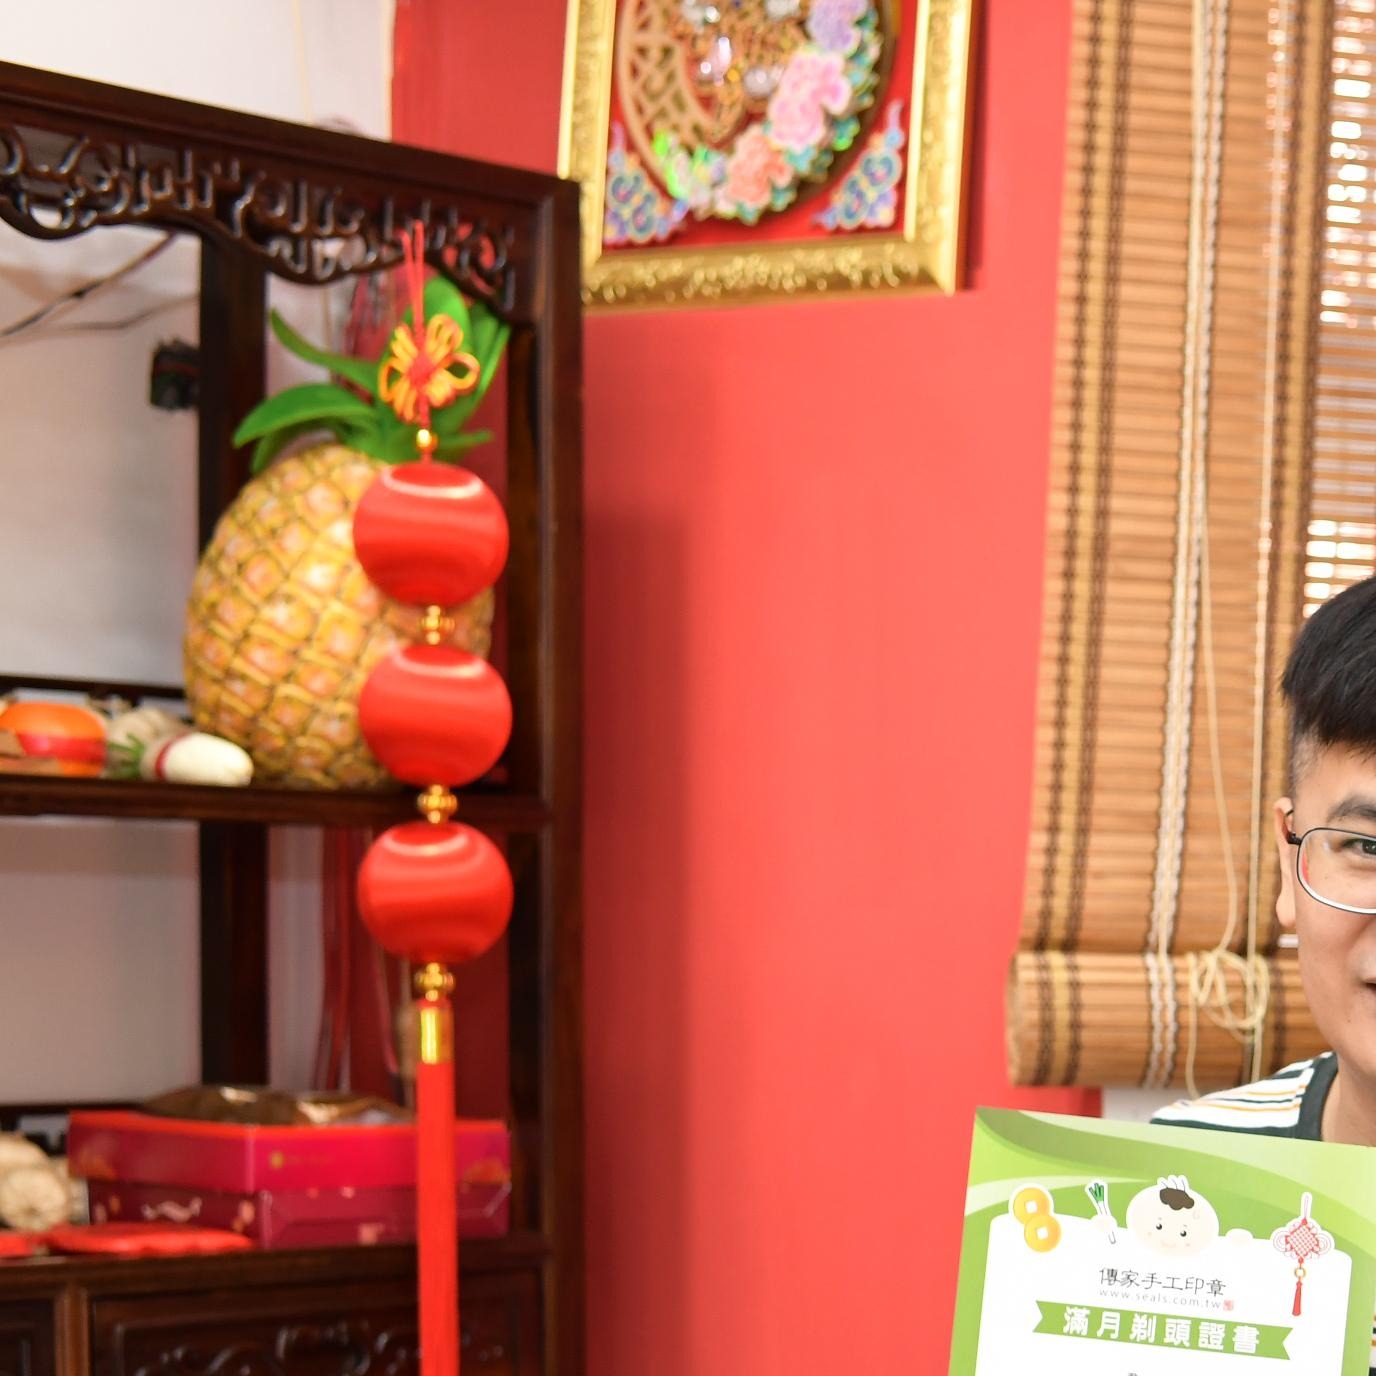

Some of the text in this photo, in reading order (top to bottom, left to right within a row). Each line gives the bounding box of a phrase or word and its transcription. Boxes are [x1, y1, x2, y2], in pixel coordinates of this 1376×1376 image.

[1098, 1267, 1227, 1297] 傳家手工印章
[1099, 1288, 1222, 1309] www.seals.com.tw
[1062, 1306, 1260, 1354] 滿月剃頭證書
